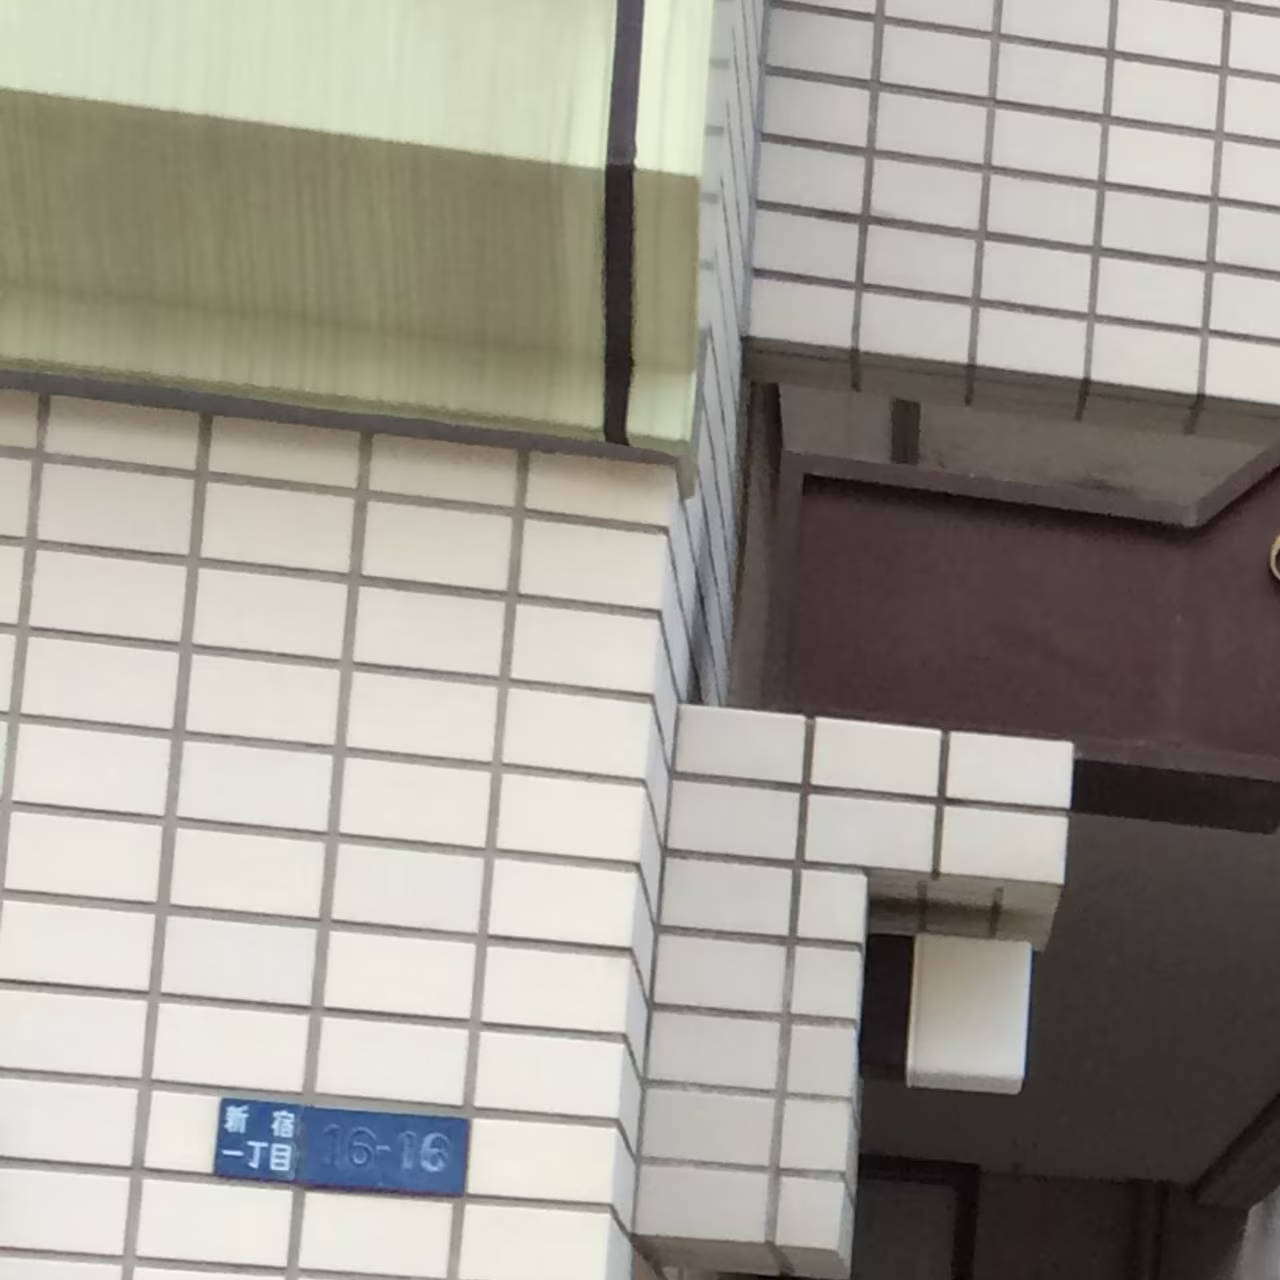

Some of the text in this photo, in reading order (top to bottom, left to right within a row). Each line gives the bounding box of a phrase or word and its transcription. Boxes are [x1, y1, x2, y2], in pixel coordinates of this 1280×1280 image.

[224, 1105, 295, 1138] 新宿
[221, 1141, 292, 1171] 一丁目
